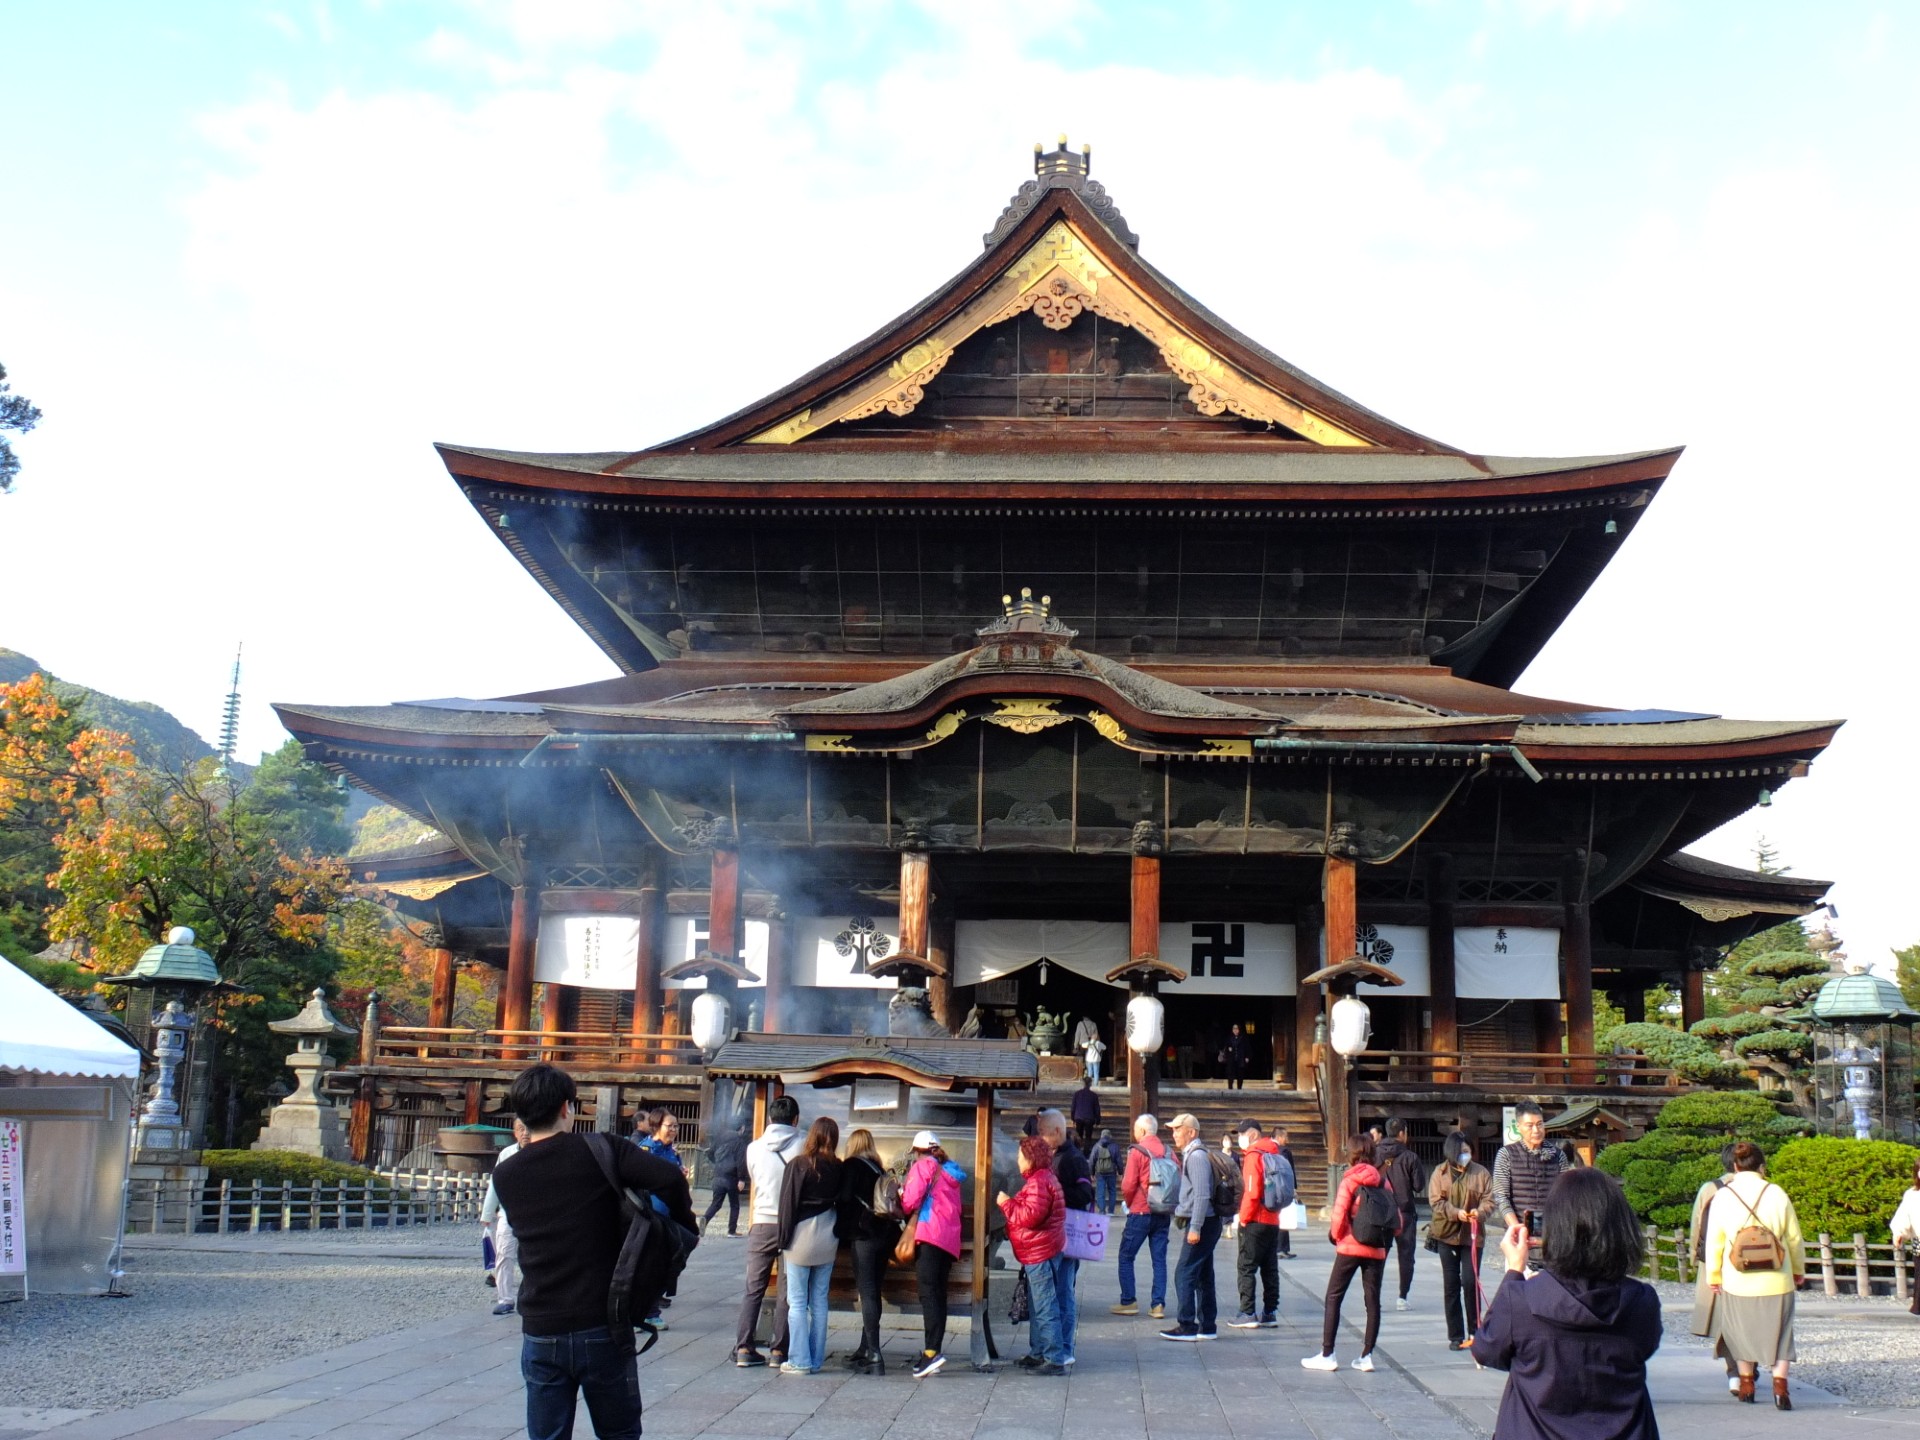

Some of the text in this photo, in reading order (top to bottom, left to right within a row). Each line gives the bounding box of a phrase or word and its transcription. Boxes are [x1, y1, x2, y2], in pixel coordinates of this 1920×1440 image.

[1494, 928, 1507, 954] 奉納
[1, 1133, 13, 1264] 七五三祈願受付所
